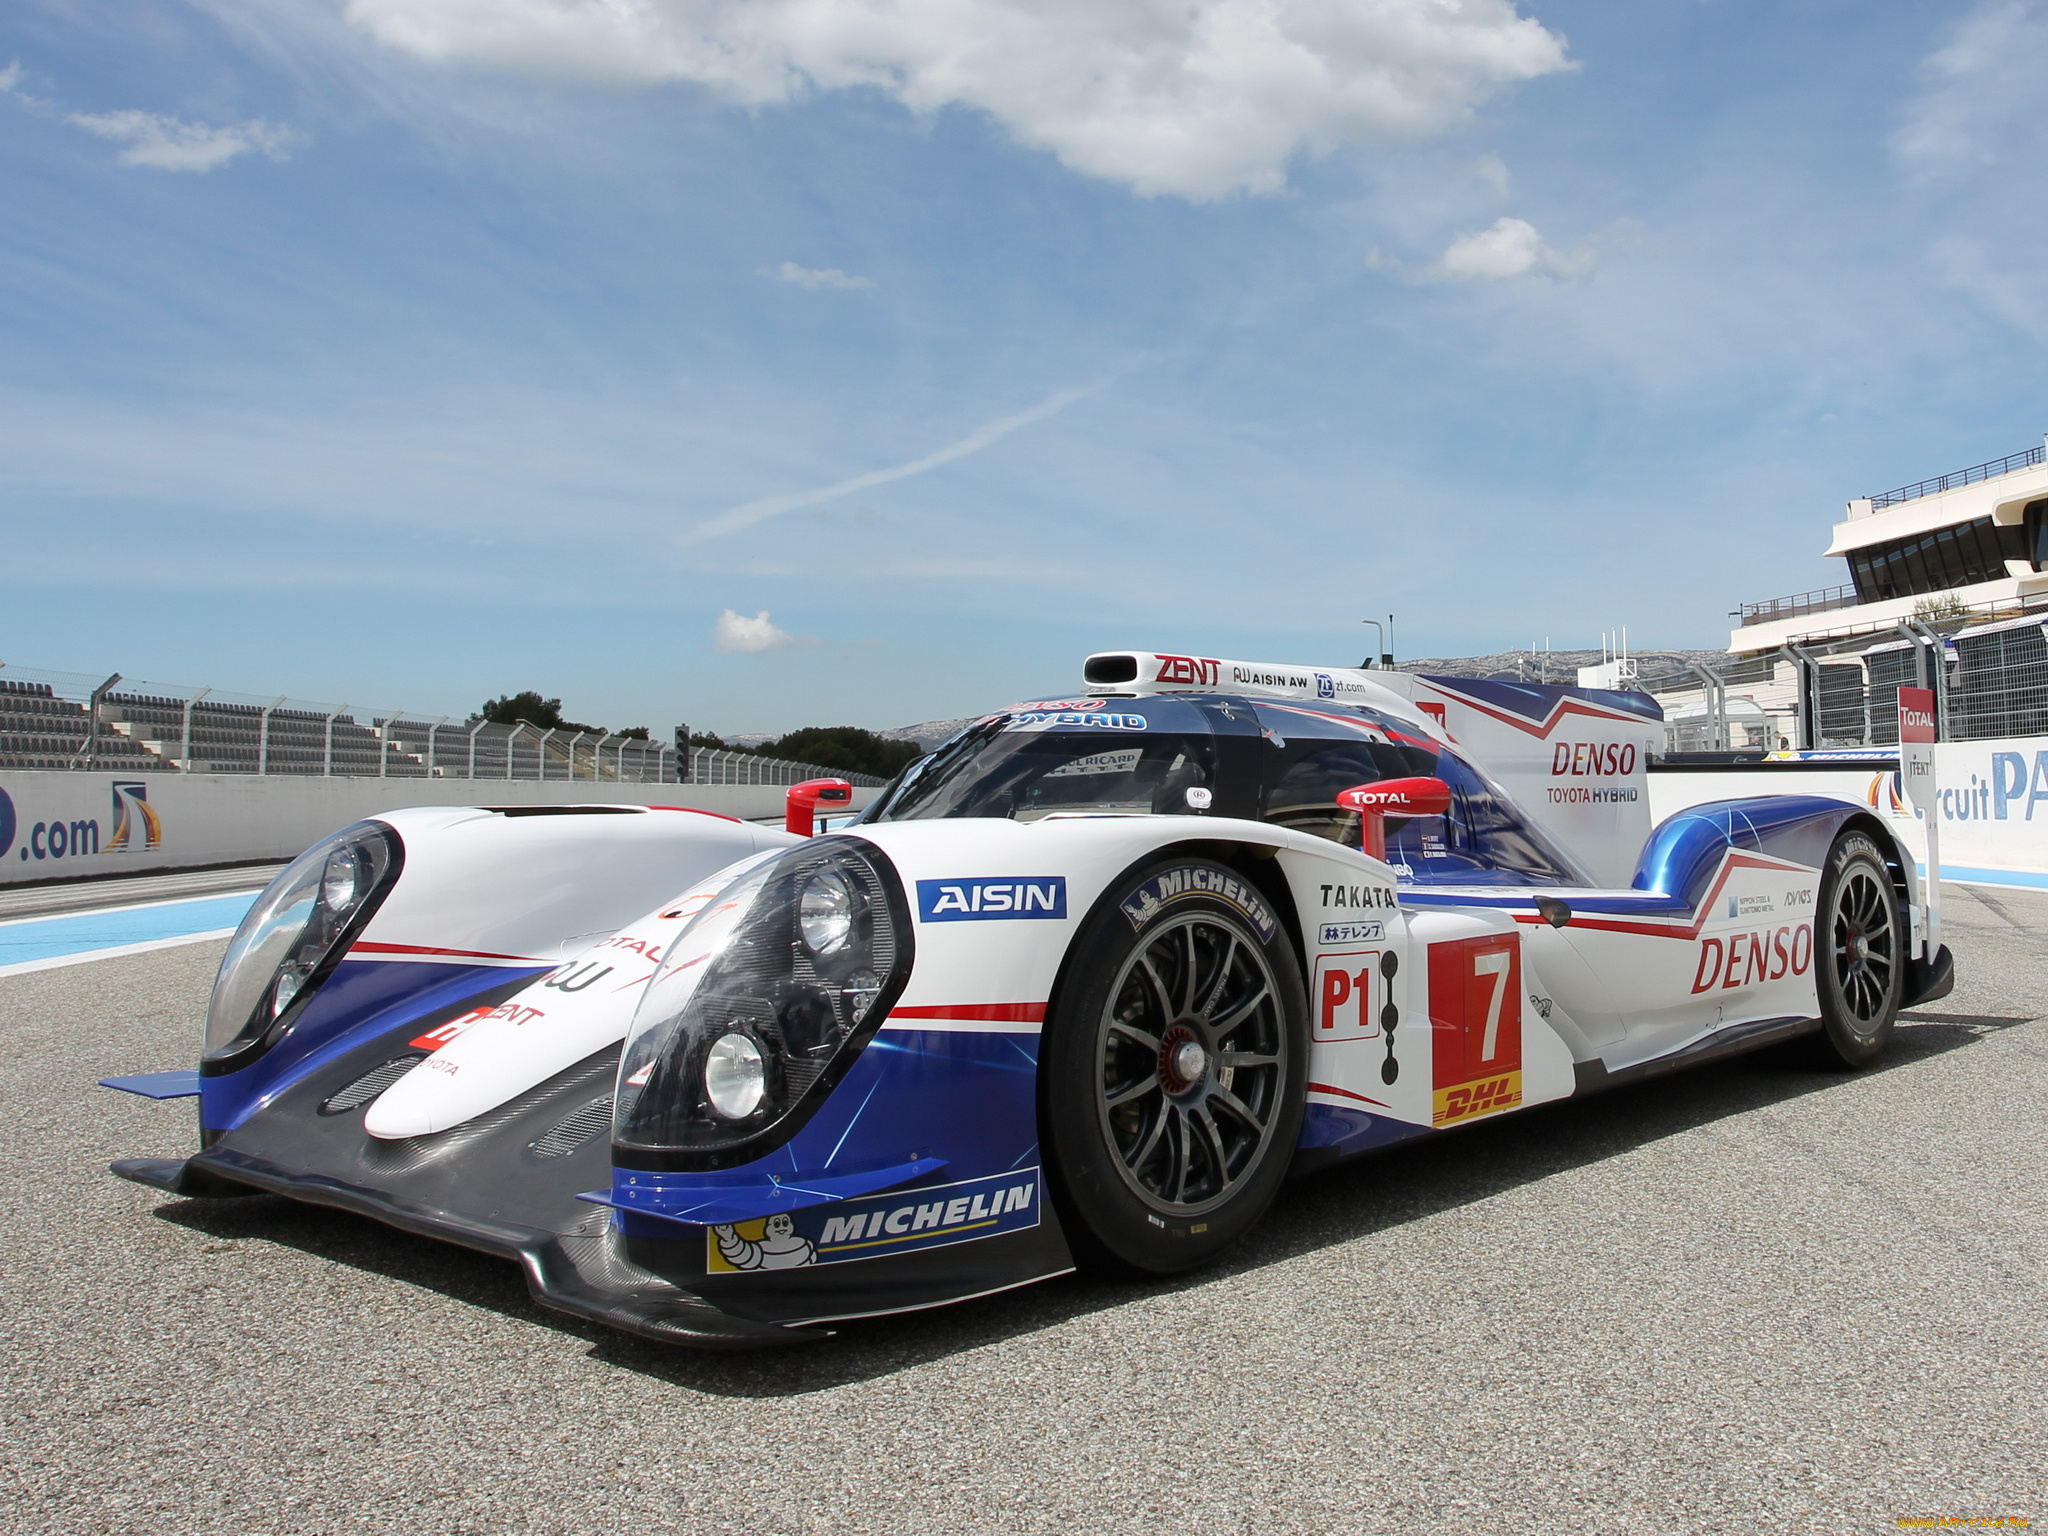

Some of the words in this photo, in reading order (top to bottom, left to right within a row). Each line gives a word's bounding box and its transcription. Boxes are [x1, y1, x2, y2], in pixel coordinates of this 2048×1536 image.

[1154, 655, 1222, 686] ZENT
[1252, 674, 1286, 687] AISIN
[1289, 677, 1308, 688] AW
[1336, 682, 1366, 693] zf.com
[1001, 713, 1148, 731] HYBRID
[1901, 707, 1934, 726] TOTAL
[1085, 754, 1135, 765] RICARD
[1552, 742, 1636, 776] DENSO
[1909, 761, 1929, 778] JTEKT
[1350, 791, 1411, 805] TOTAL
[1547, 788, 1591, 804] TOYOTA
[1592, 787, 1638, 803] HYBRID
[932, 884, 1056, 914] AISIN
[1158, 869, 1273, 932] MICHELIN
[1320, 884, 1396, 908] TAKATA
[1690, 922, 1813, 995] DENSO
[1321, 967, 1370, 1030] P1
[1474, 951, 1511, 1063] 7
[1444, 1077, 1514, 1121] DHL
[819, 1182, 1035, 1245] MICHELIN
